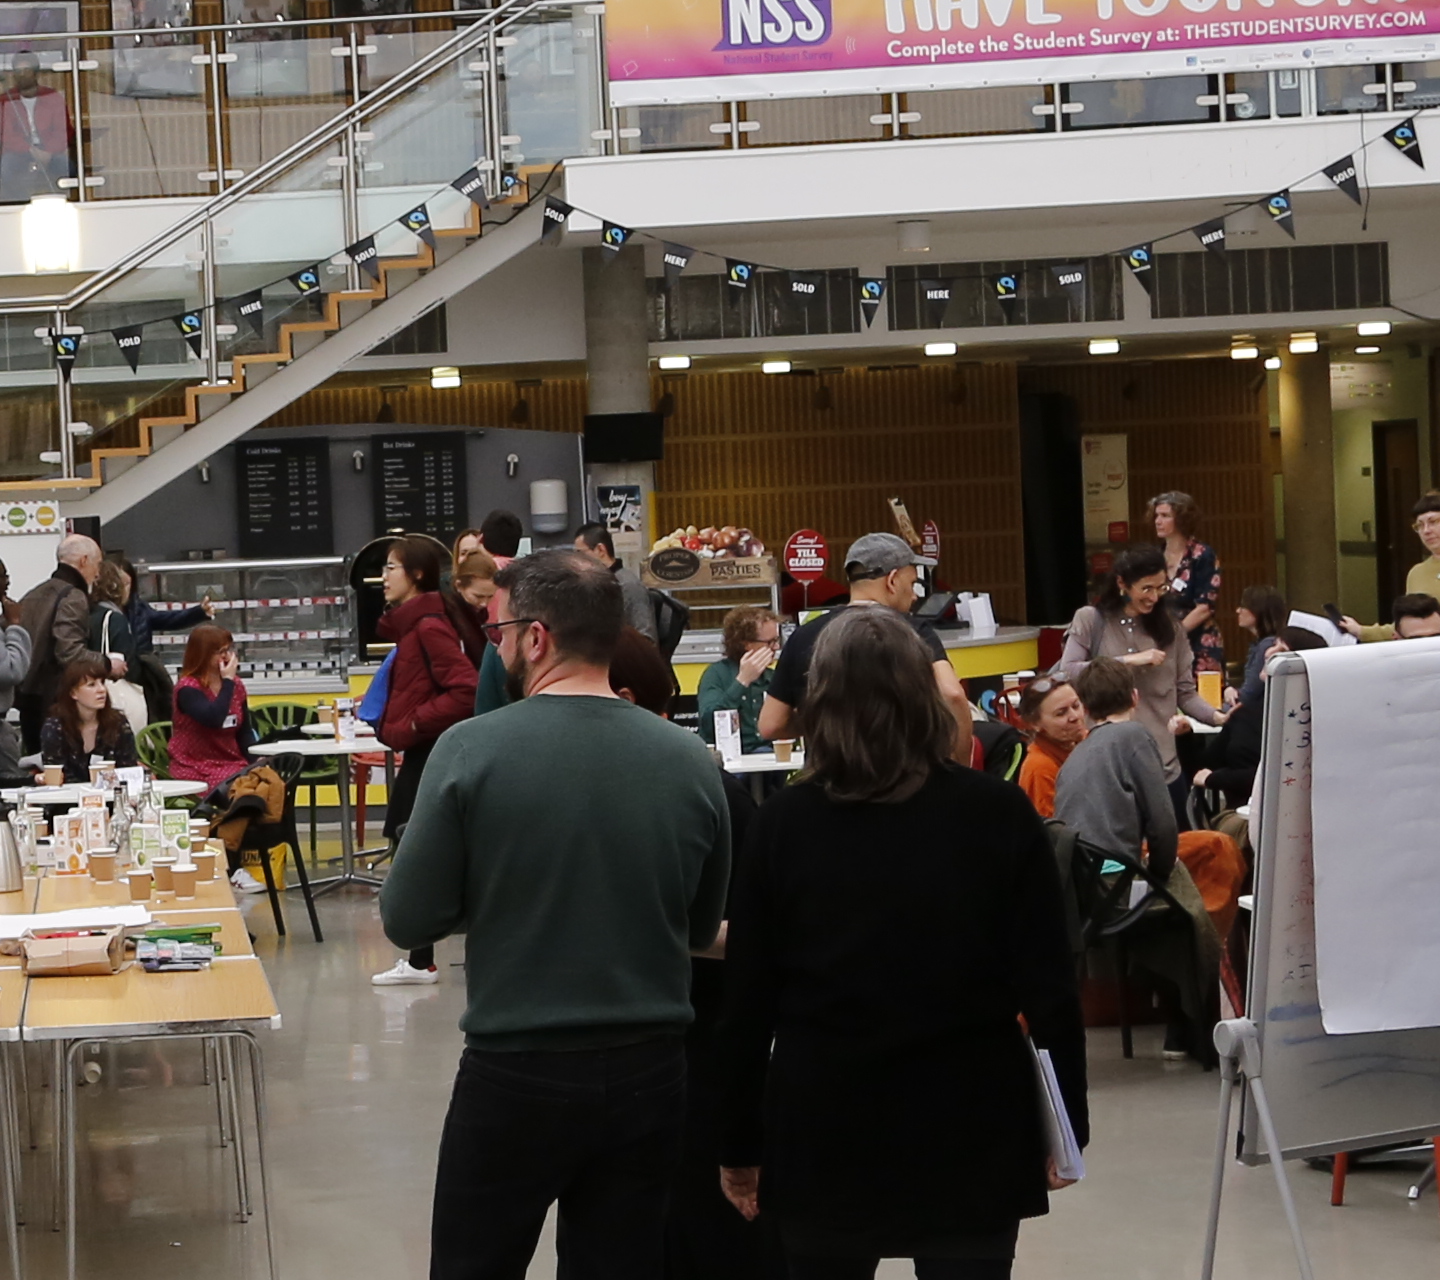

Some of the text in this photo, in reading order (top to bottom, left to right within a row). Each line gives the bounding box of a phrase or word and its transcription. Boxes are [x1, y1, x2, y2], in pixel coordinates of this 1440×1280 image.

[887, 10, 1427, 62] Complete the Student Survey at: THESTUDENTSURVEY.COM
[1332, 166, 1356, 186] SOLD
[461, 177, 483, 196] HERE
[544, 207, 565, 223] SOLD
[1201, 228, 1225, 246] HERE
[354, 247, 376, 264] SOLD
[664, 254, 687, 268] HERE
[1058, 272, 1082, 286] SOLD
[792, 281, 815, 294] SOLD
[927, 289, 950, 300] HERE
[240, 300, 262, 316] HERE
[119, 335, 141, 348] SOLD
[796, 535, 818, 545] Sorry!
[796, 548, 817, 558] TILL
[788, 558, 824, 567] CLOSED
[711, 563, 761, 577] PASTIES
